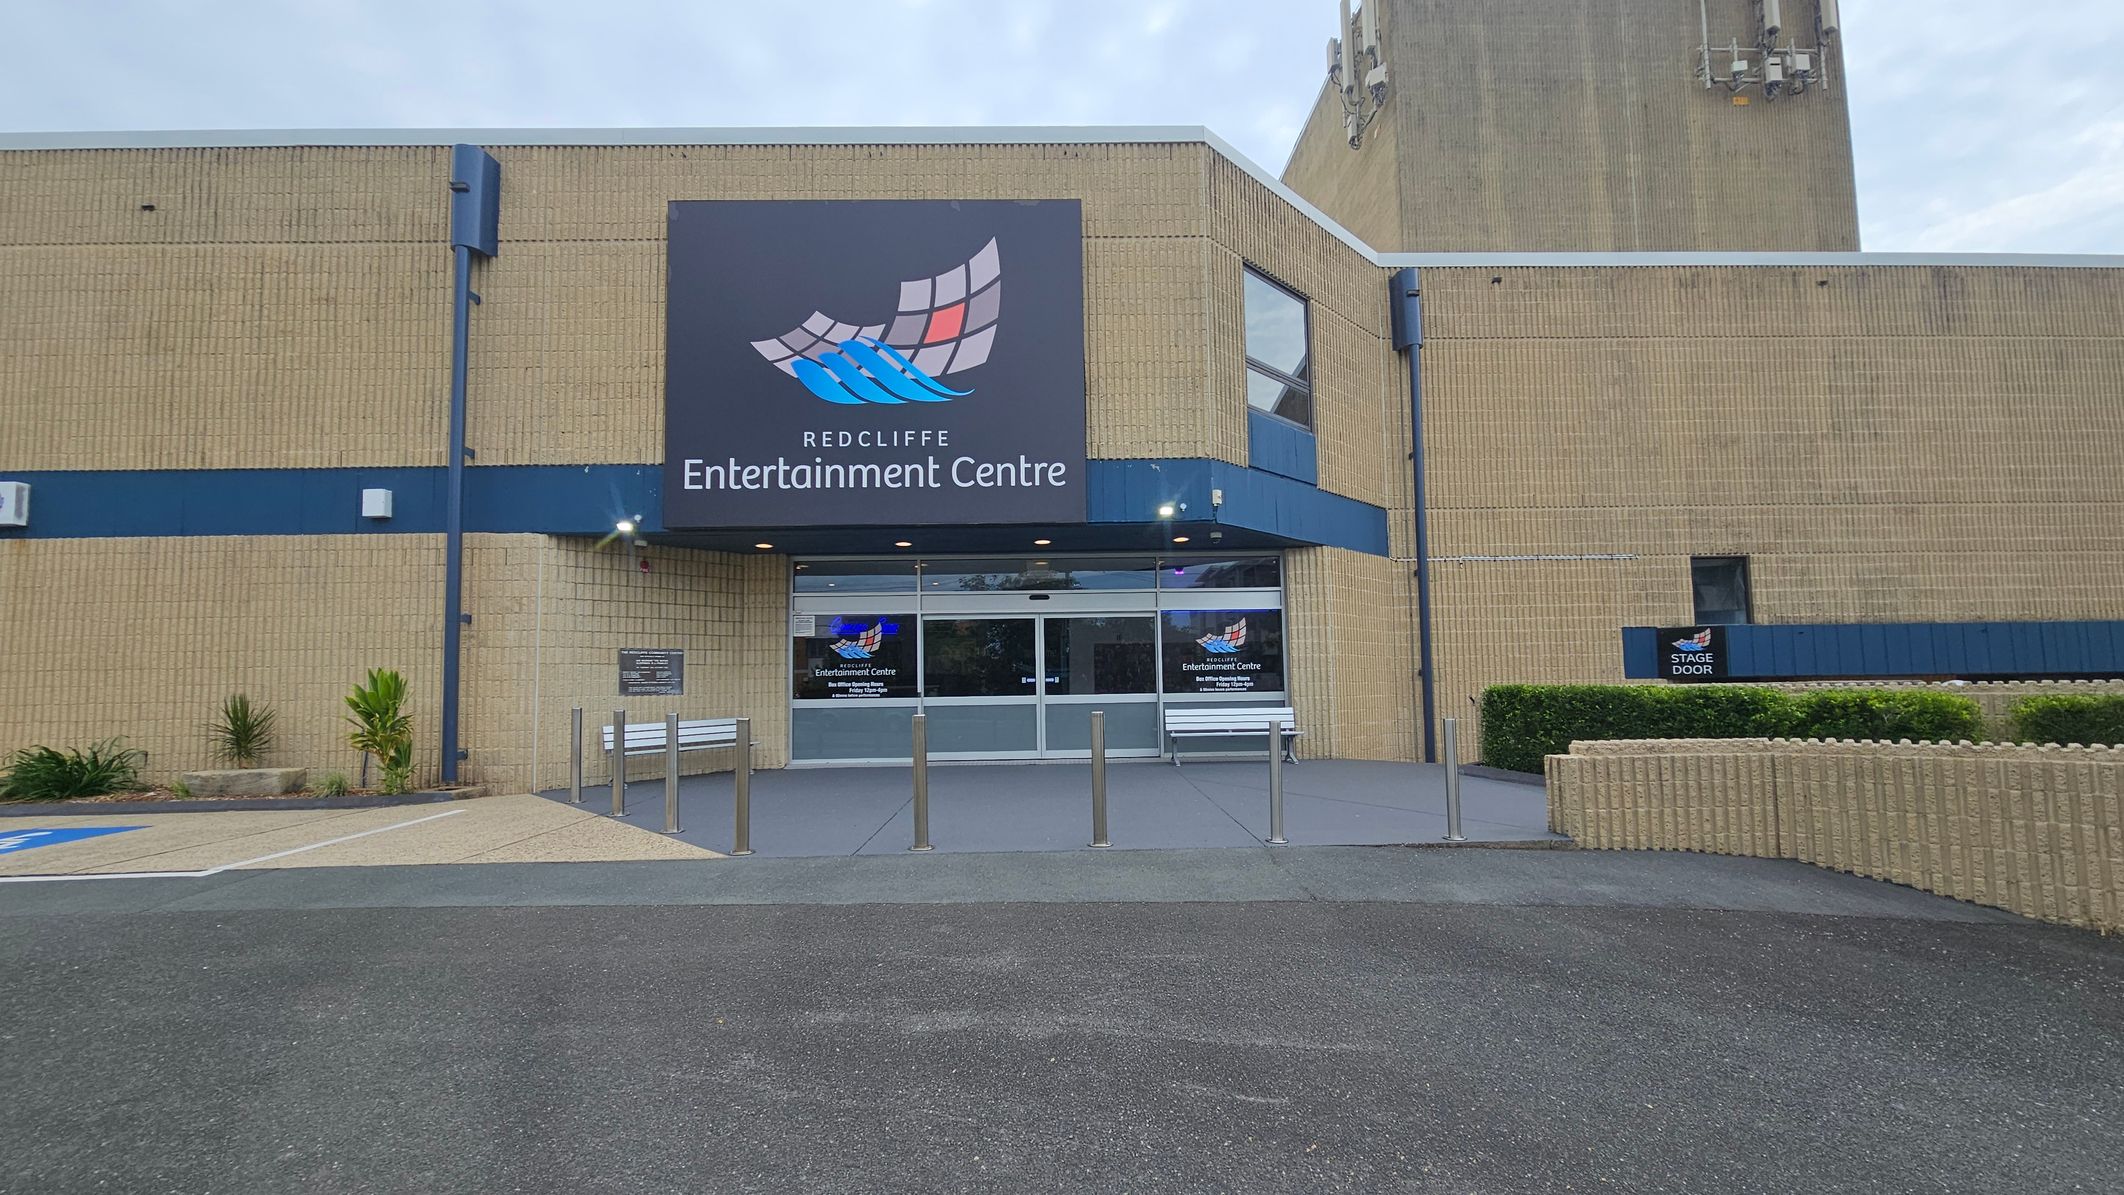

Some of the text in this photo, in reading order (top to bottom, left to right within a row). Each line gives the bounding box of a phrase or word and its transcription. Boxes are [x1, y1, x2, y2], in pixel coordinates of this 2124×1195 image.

[803, 430, 950, 447] REDCLIFFE
[683, 454, 1067, 490] Entertainment Centre
[1671, 653, 1714, 663] STAGE
[1182, 662, 1261, 671] Entertainment Centre
[1672, 665, 1713, 675] DOOR
[815, 668, 896, 677] Entertainment Centre
